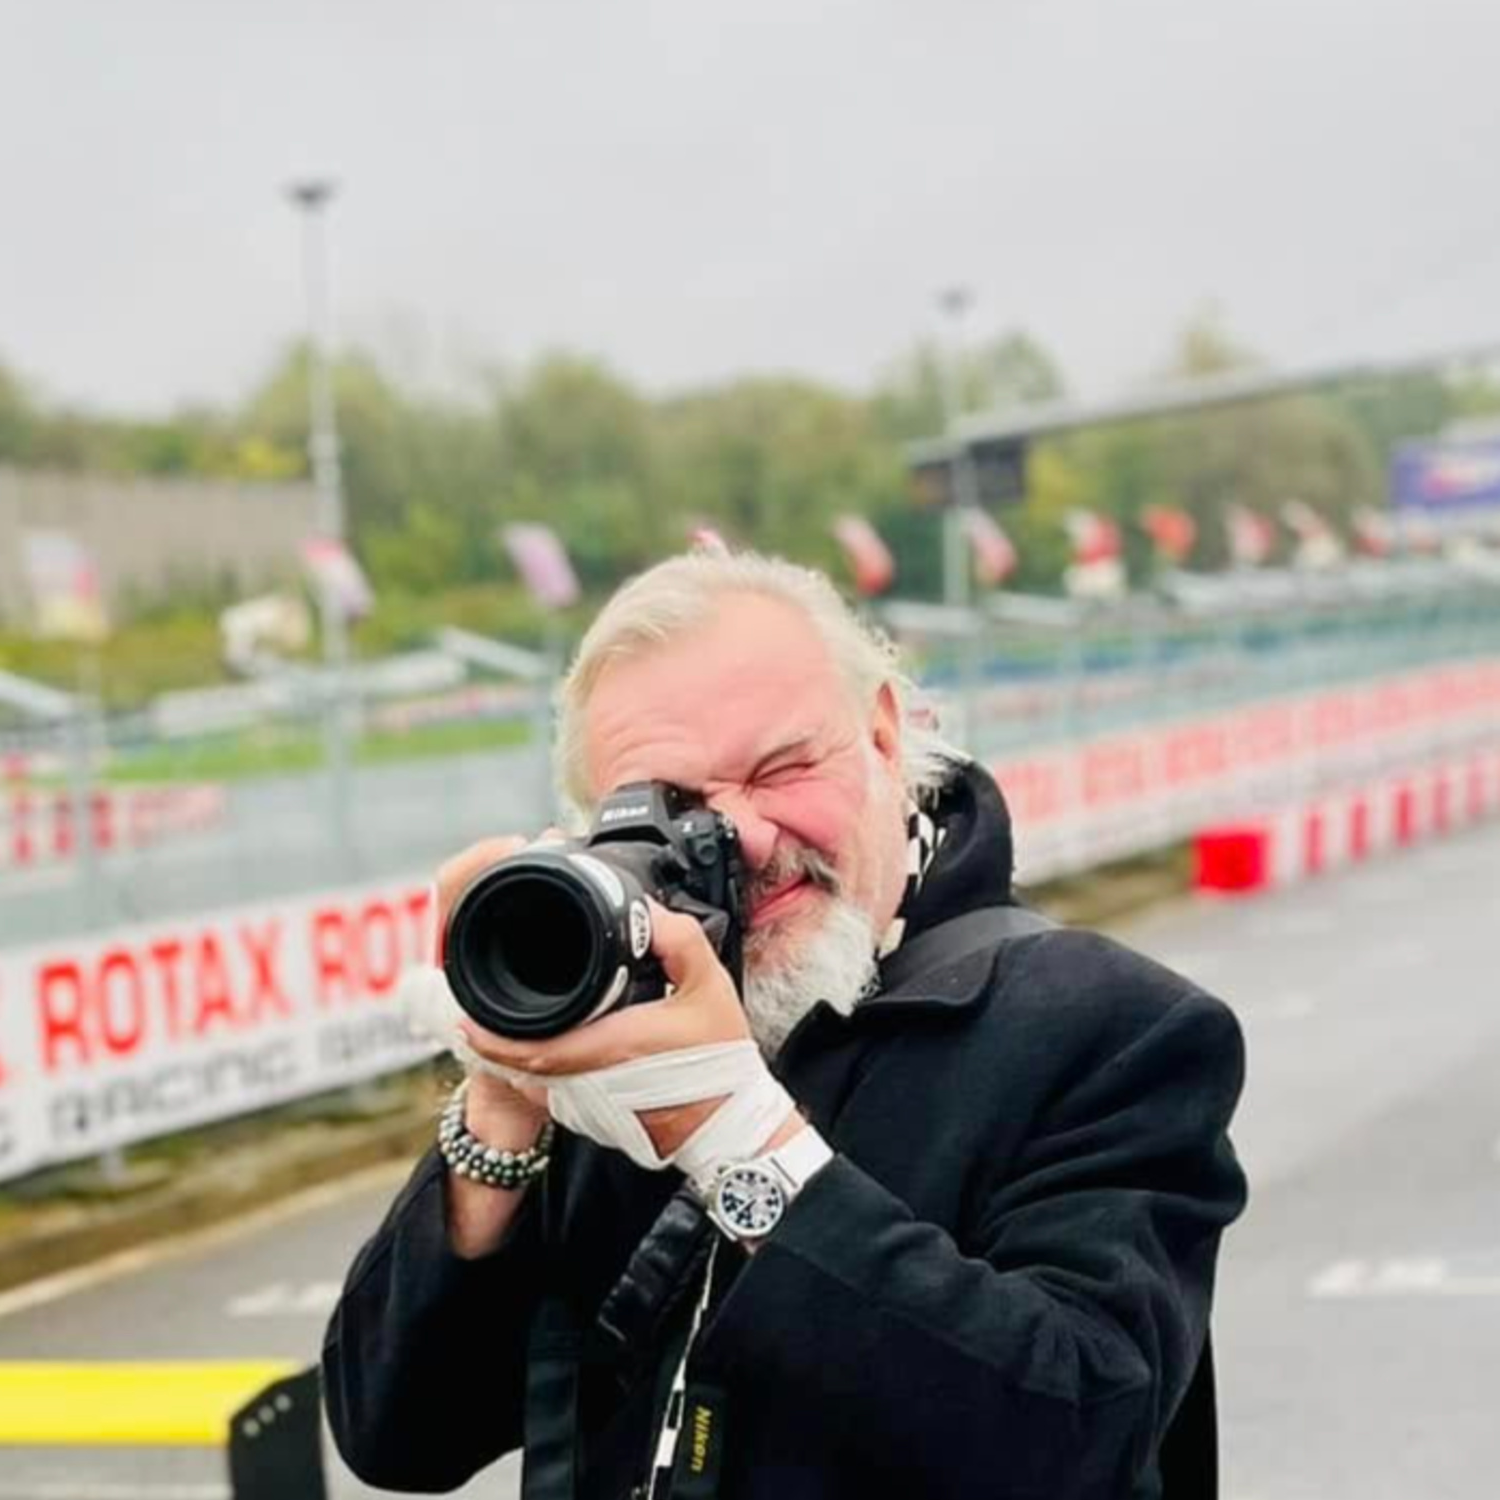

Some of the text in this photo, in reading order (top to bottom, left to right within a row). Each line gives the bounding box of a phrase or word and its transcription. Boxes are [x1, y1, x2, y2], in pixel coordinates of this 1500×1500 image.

[601, 805, 649, 822] Nikon
[38, 919, 291, 1072] ROTAX
[313, 891, 438, 1008] ROT
[692, 1407, 712, 1471] Nikon
